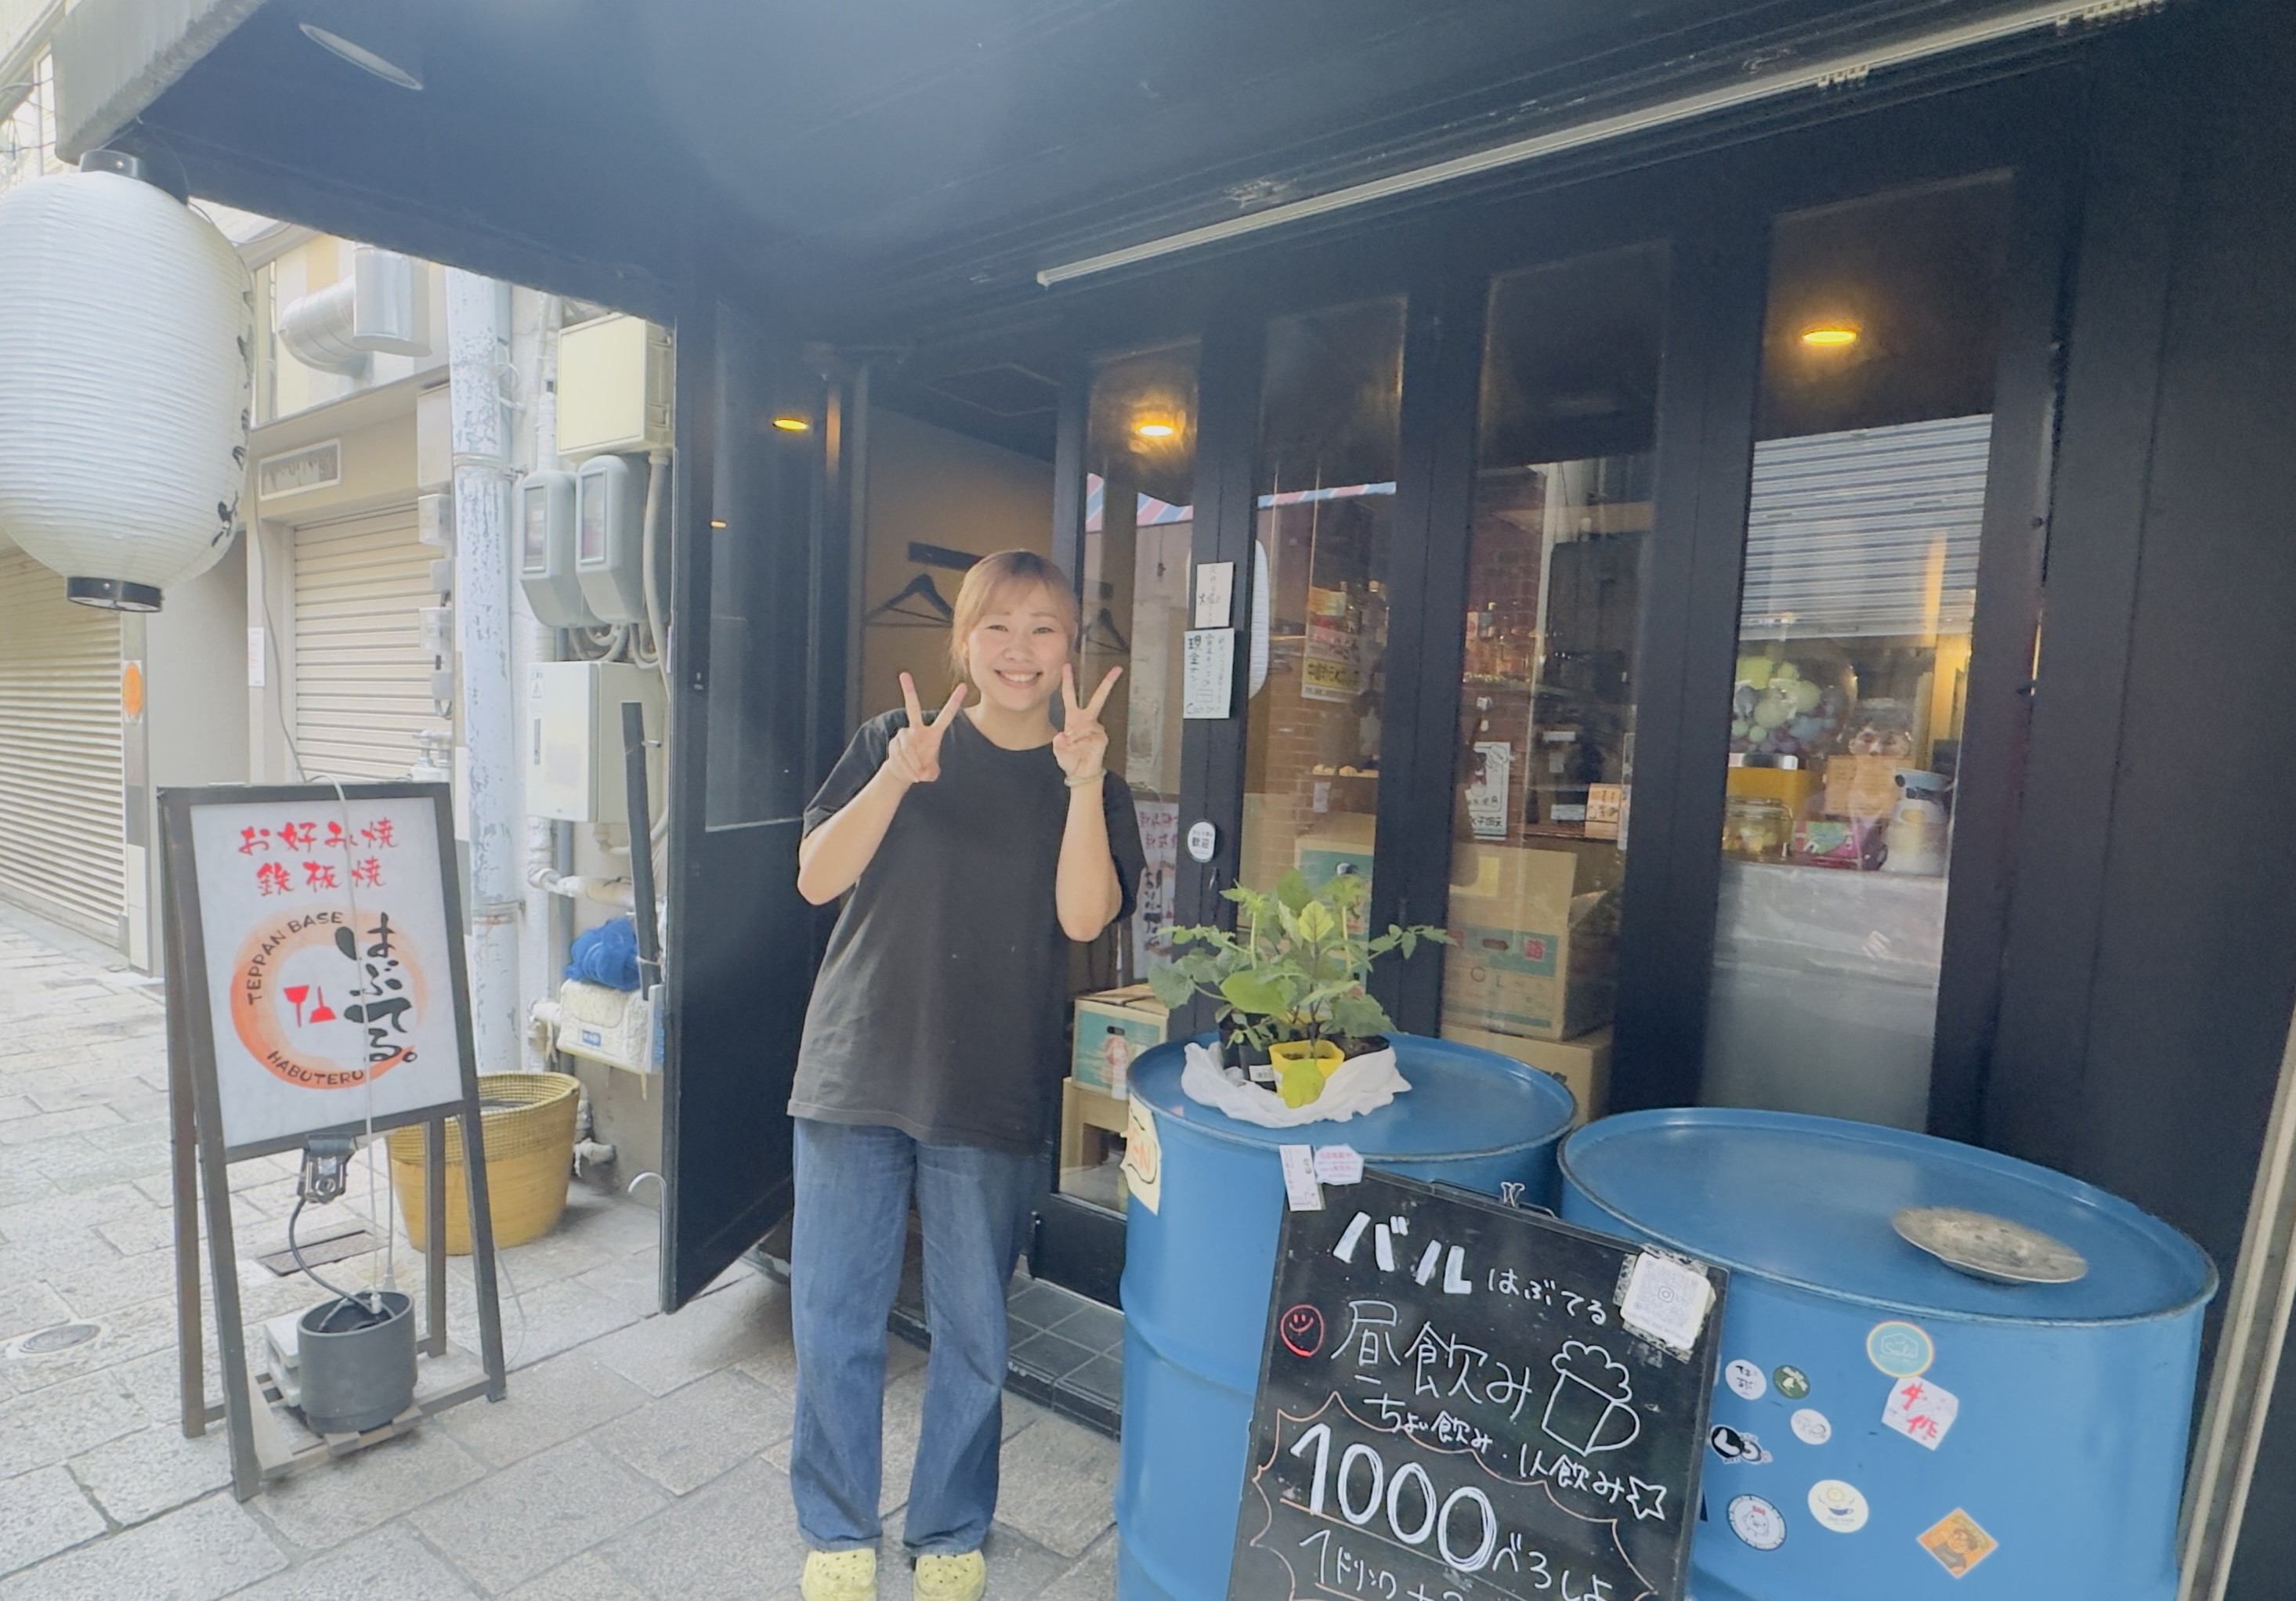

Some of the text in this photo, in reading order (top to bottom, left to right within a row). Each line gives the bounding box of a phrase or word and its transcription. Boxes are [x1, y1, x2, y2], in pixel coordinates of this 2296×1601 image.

[238, 816, 400, 856] お好み焼
[256, 855, 387, 897] 鉄板焼
[248, 911, 343, 1006] TEPPAN BASE
[266, 1050, 365, 1086] HABUTERU
[1333, 1212, 1607, 1326] バル はぶてる
[1331, 1300, 1533, 1422] 昼飲み
